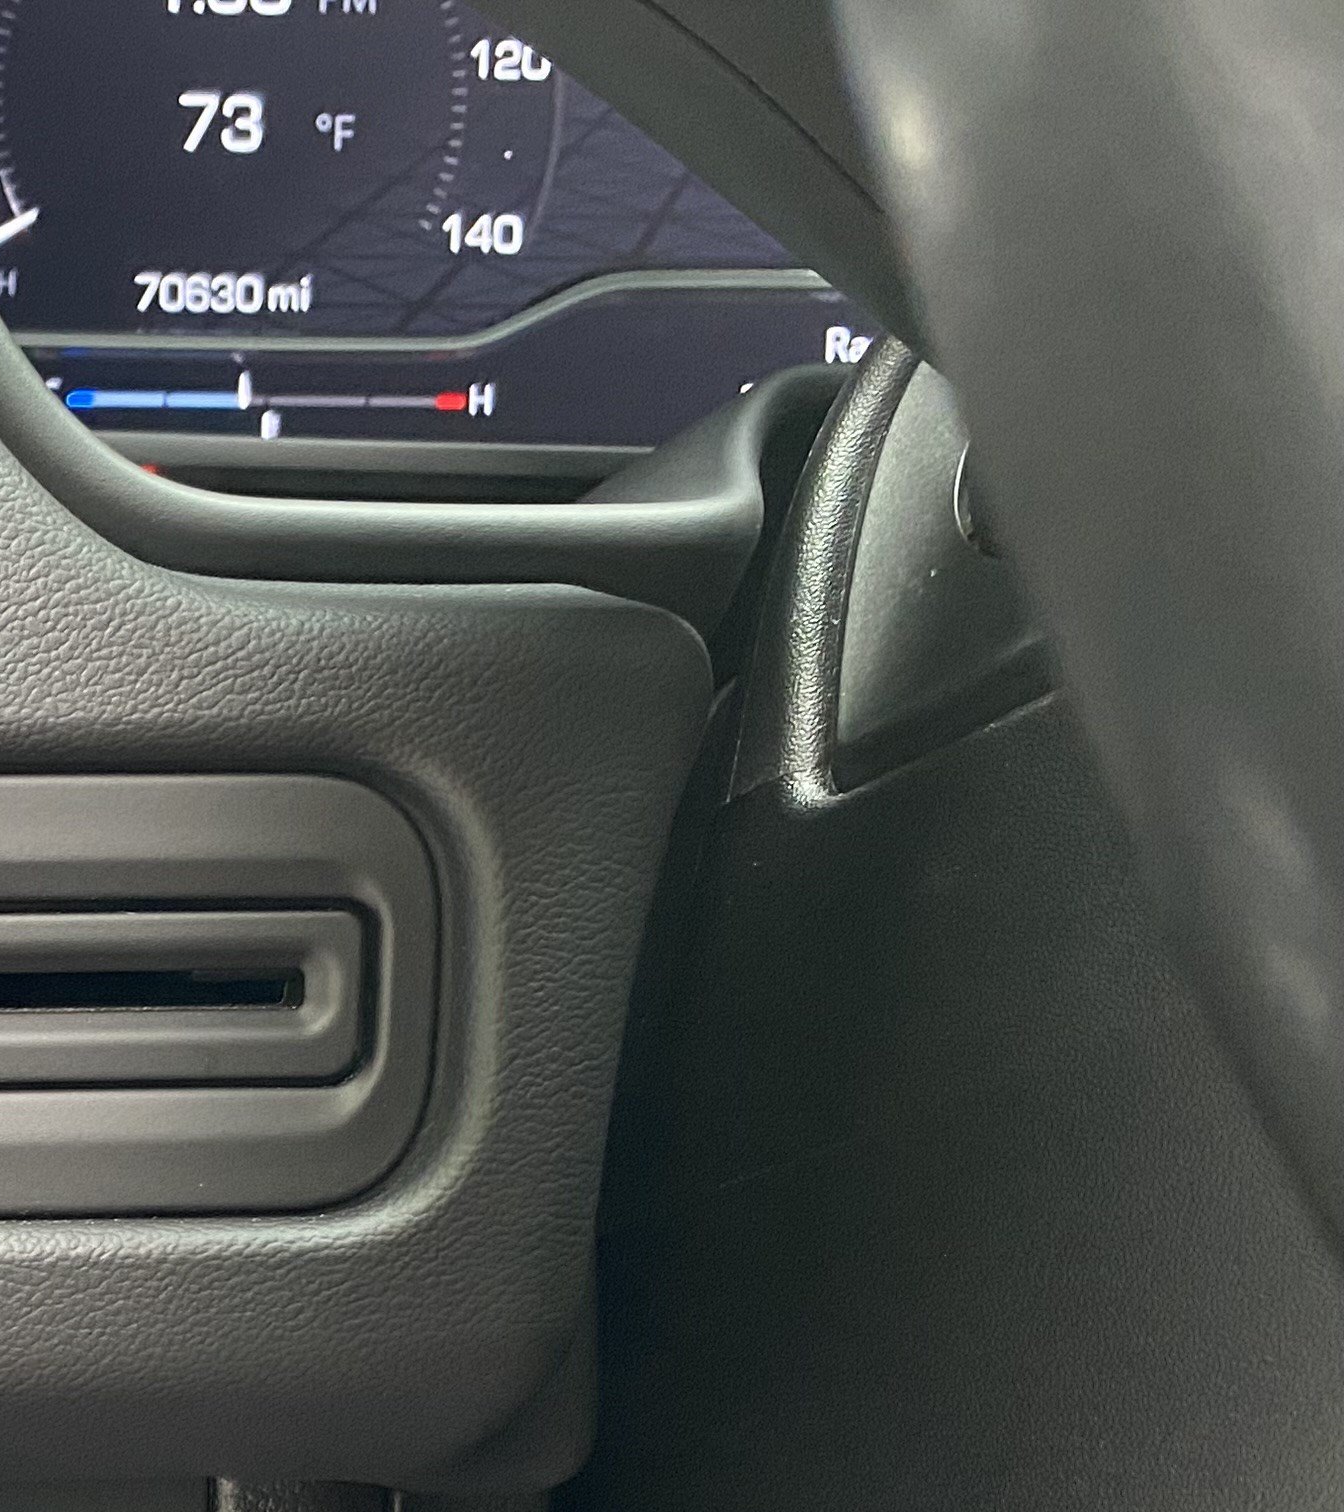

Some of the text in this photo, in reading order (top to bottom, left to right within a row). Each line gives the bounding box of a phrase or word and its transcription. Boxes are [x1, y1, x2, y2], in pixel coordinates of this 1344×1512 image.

[470, 38, 553, 82] 120
[178, 91, 265, 153] 73
[441, 212, 524, 255] 140
[133, 271, 264, 314] 70630
[824, 326, 874, 364] Ra
[468, 383, 496, 417] H
